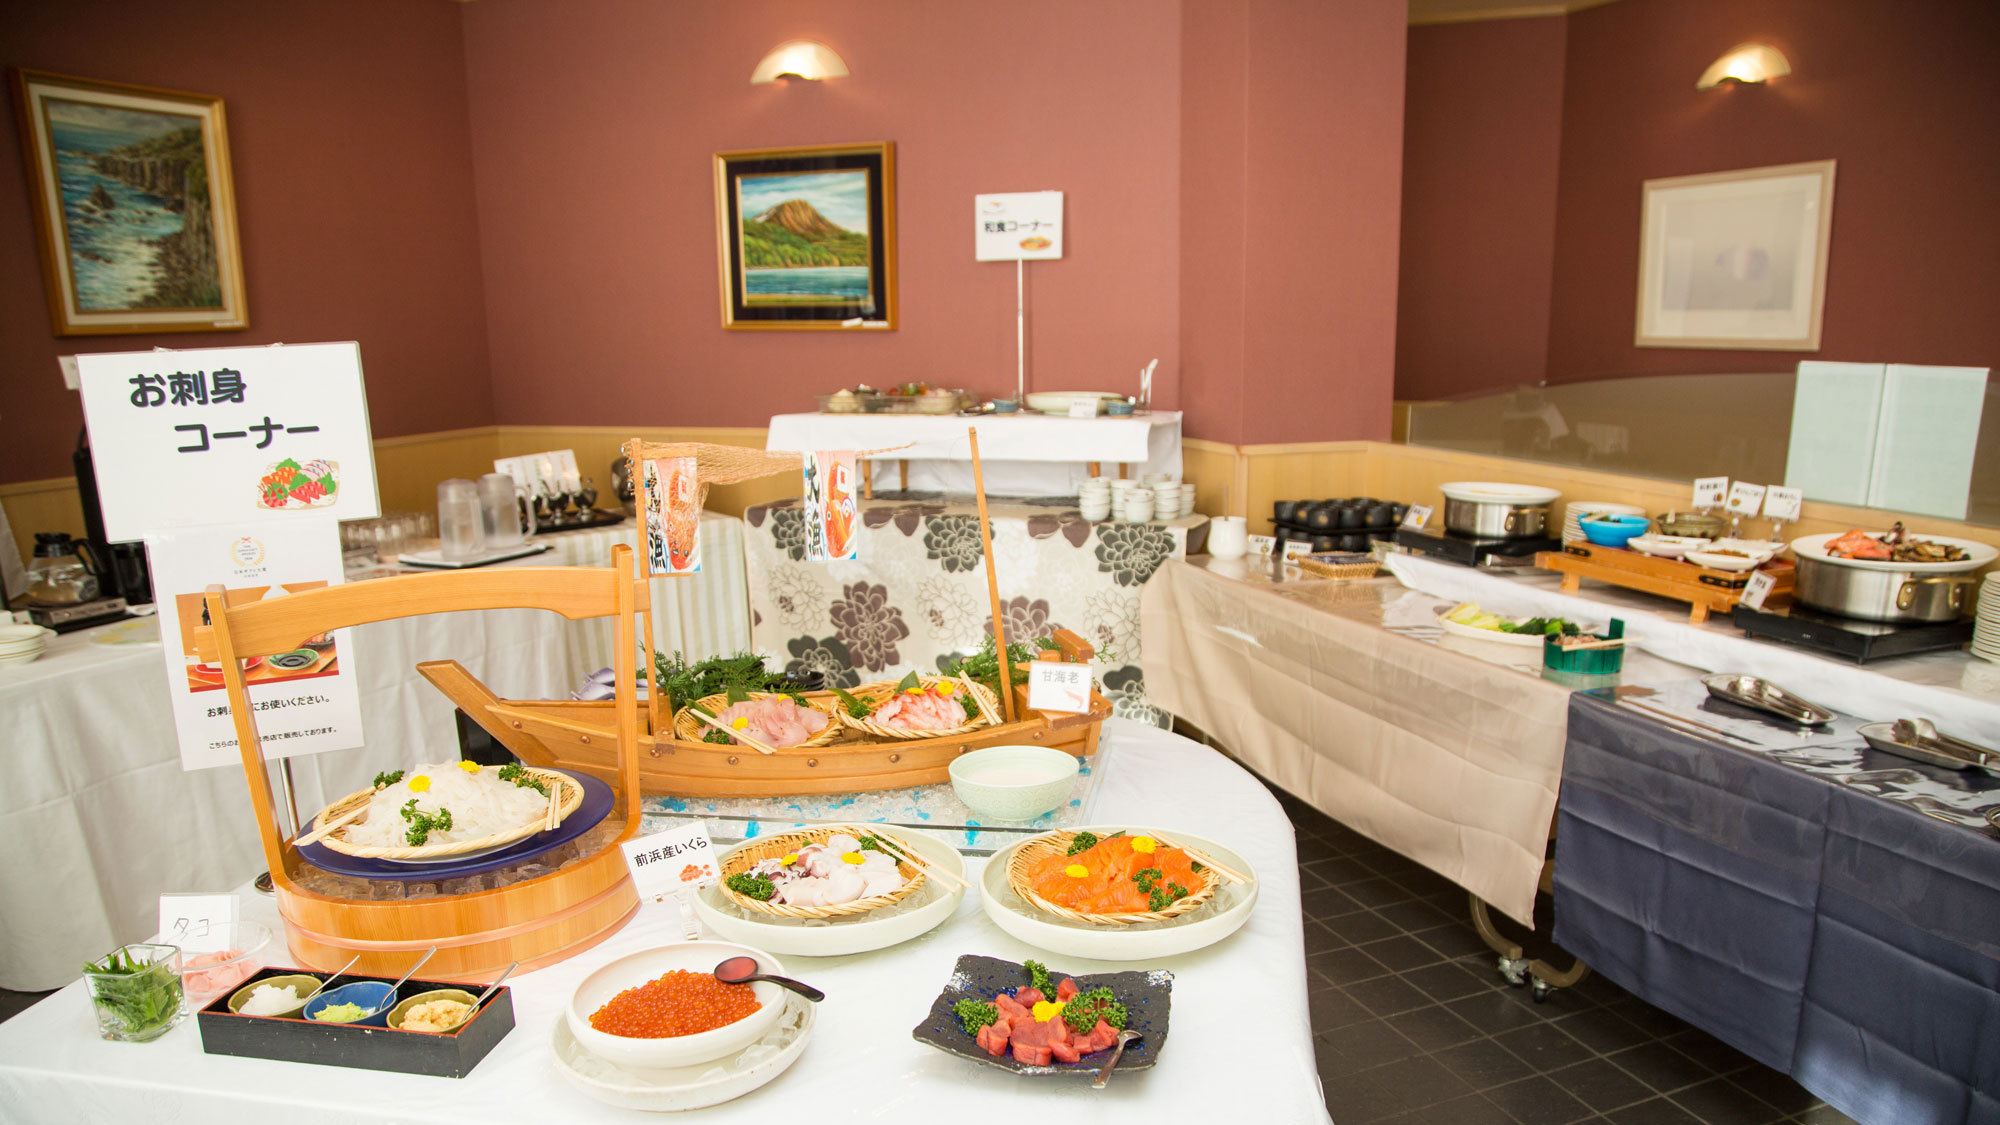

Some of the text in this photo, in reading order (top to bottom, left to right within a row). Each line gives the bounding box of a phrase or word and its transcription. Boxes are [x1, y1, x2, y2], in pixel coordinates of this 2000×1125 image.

[984, 221, 1054, 233] 和食コーナー
[129, 368, 247, 408] お刺身
[174, 416, 320, 453] コーナー
[1042, 669, 1080, 684] 甘海老
[634, 836, 708, 868] 前浜産いくら
